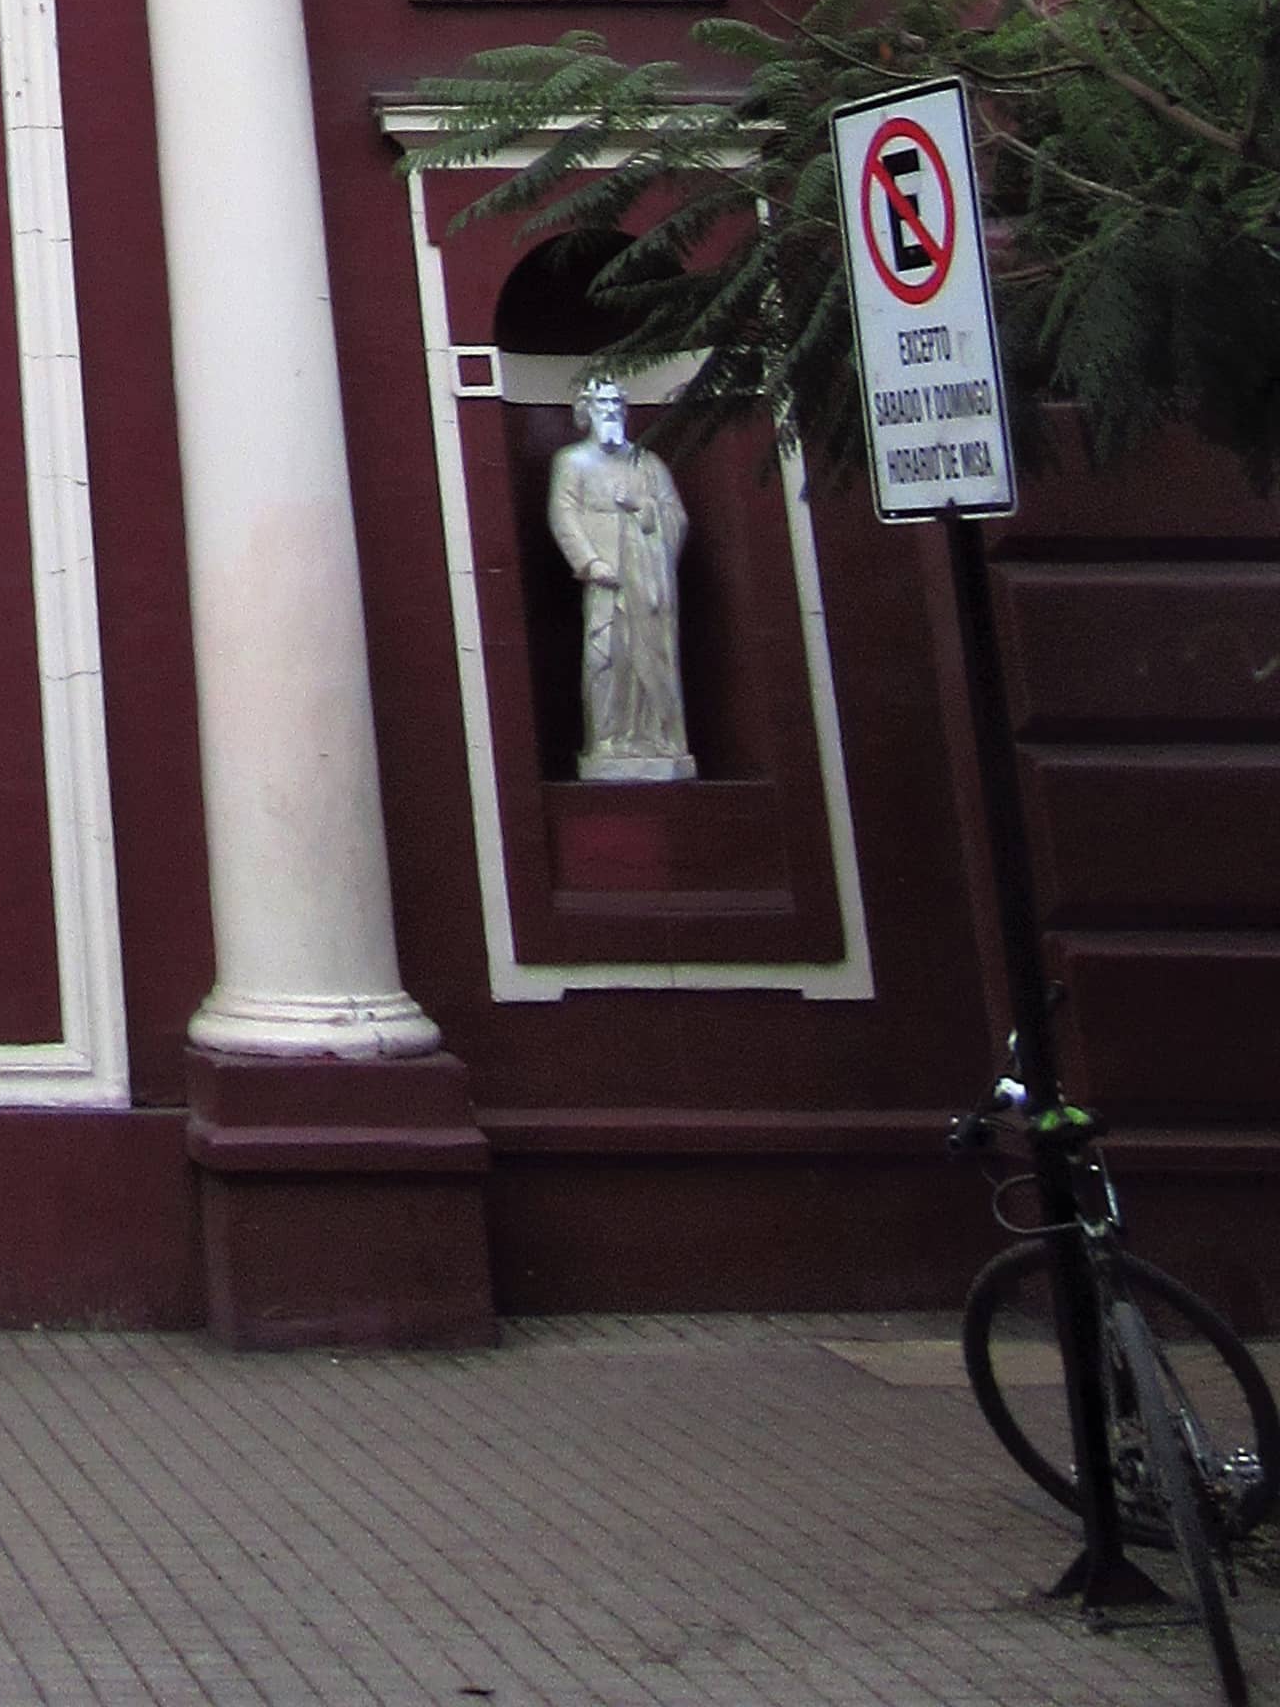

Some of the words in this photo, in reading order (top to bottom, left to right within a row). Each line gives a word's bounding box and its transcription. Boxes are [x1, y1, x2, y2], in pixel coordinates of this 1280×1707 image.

[898, 325, 951, 366] EXCEPTO
[874, 388, 922, 426] SABADO
[921, 386, 933, 420] Y
[934, 379, 992, 419] DOMINGO
[887, 446, 940, 485] HORARIO
[940, 444, 960, 480] DE
[960, 441, 994, 477] MISA
